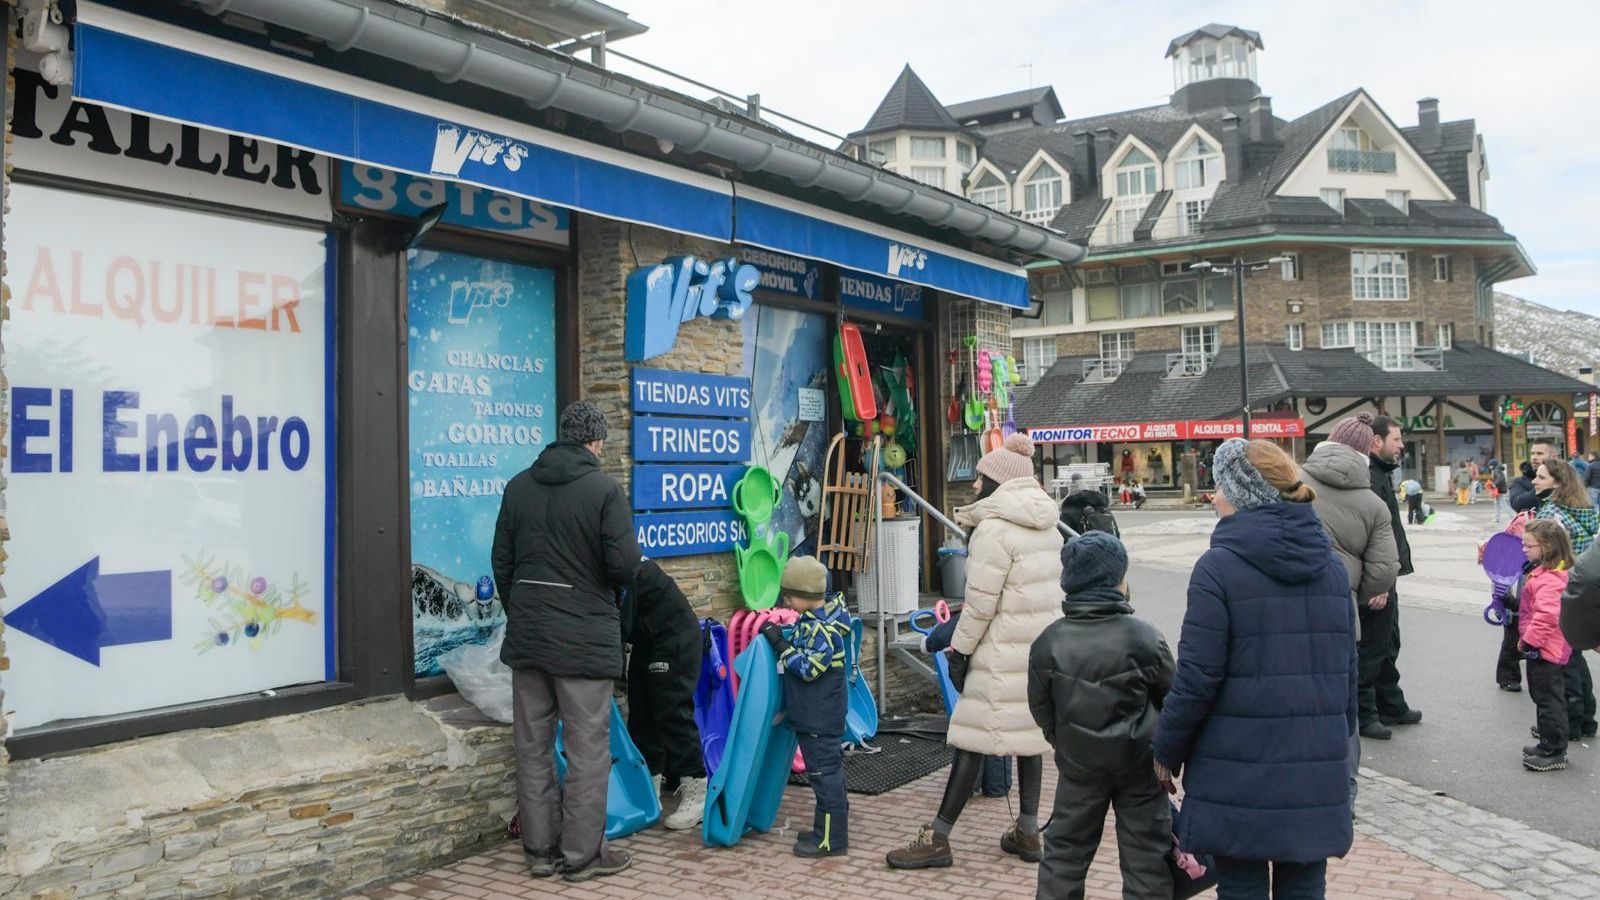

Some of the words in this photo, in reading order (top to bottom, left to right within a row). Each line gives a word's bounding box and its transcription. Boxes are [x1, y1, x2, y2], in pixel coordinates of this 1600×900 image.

[10, 67, 322, 195] TALLER
[430, 123, 528, 177] Vit's
[21, 246, 301, 334] ALQUILER
[840, 276, 892, 303] TIENDAS
[625, 255, 760, 361] Vit's
[448, 351, 544, 373] CHANCLAS
[408, 370, 492, 396] GAFAS
[636, 381, 710, 406] TIENDAS
[715, 386, 750, 409] VITS
[473, 401, 544, 418] TAPONES
[11, 386, 73, 473] El
[102, 390, 310, 473] Enebro
[448, 422, 543, 445] GORROS
[648, 427, 740, 454] TRINEOS
[1031, 427, 1137, 441] MONITORTECNO
[1193, 424, 1235, 435] ALQUILER
[1252, 423, 1283, 434] RENTAL
[423, 452, 497, 467] TOALLAS
[423, 475, 509, 498] BAÑADO
[662, 473, 727, 502] ROPA
[637, 521, 727, 548] ACCESORIOS
[730, 520, 749, 542] SK
